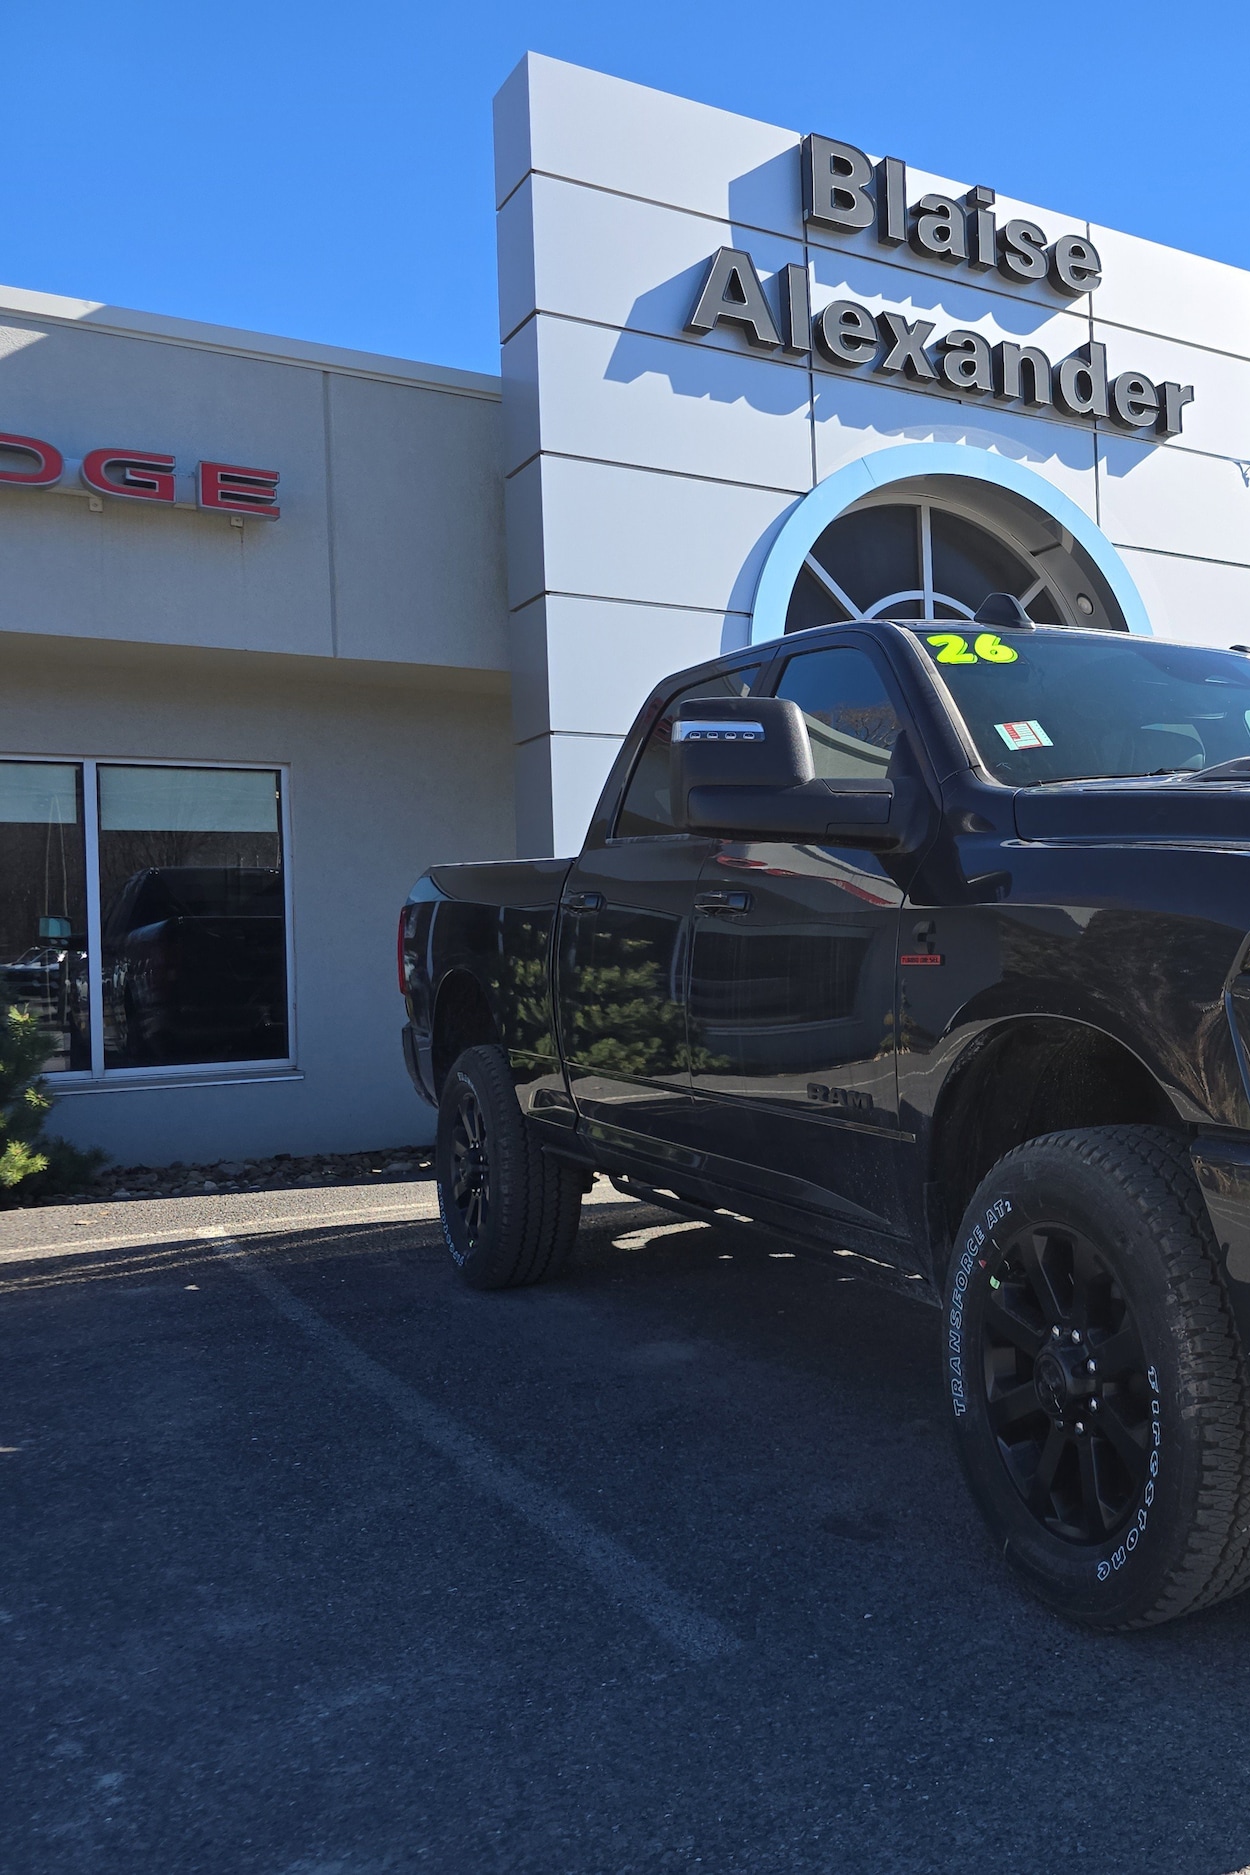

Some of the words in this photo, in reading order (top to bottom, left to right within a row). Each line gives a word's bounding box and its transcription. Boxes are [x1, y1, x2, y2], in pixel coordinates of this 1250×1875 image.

[803, 133, 1102, 296] Blaise
[683, 246, 1194, 437] Alexander
[926, 633, 1018, 664] 26
[807, 1082, 874, 1110] RAM
[949, 1225, 985, 1417] TRANSFORCE
